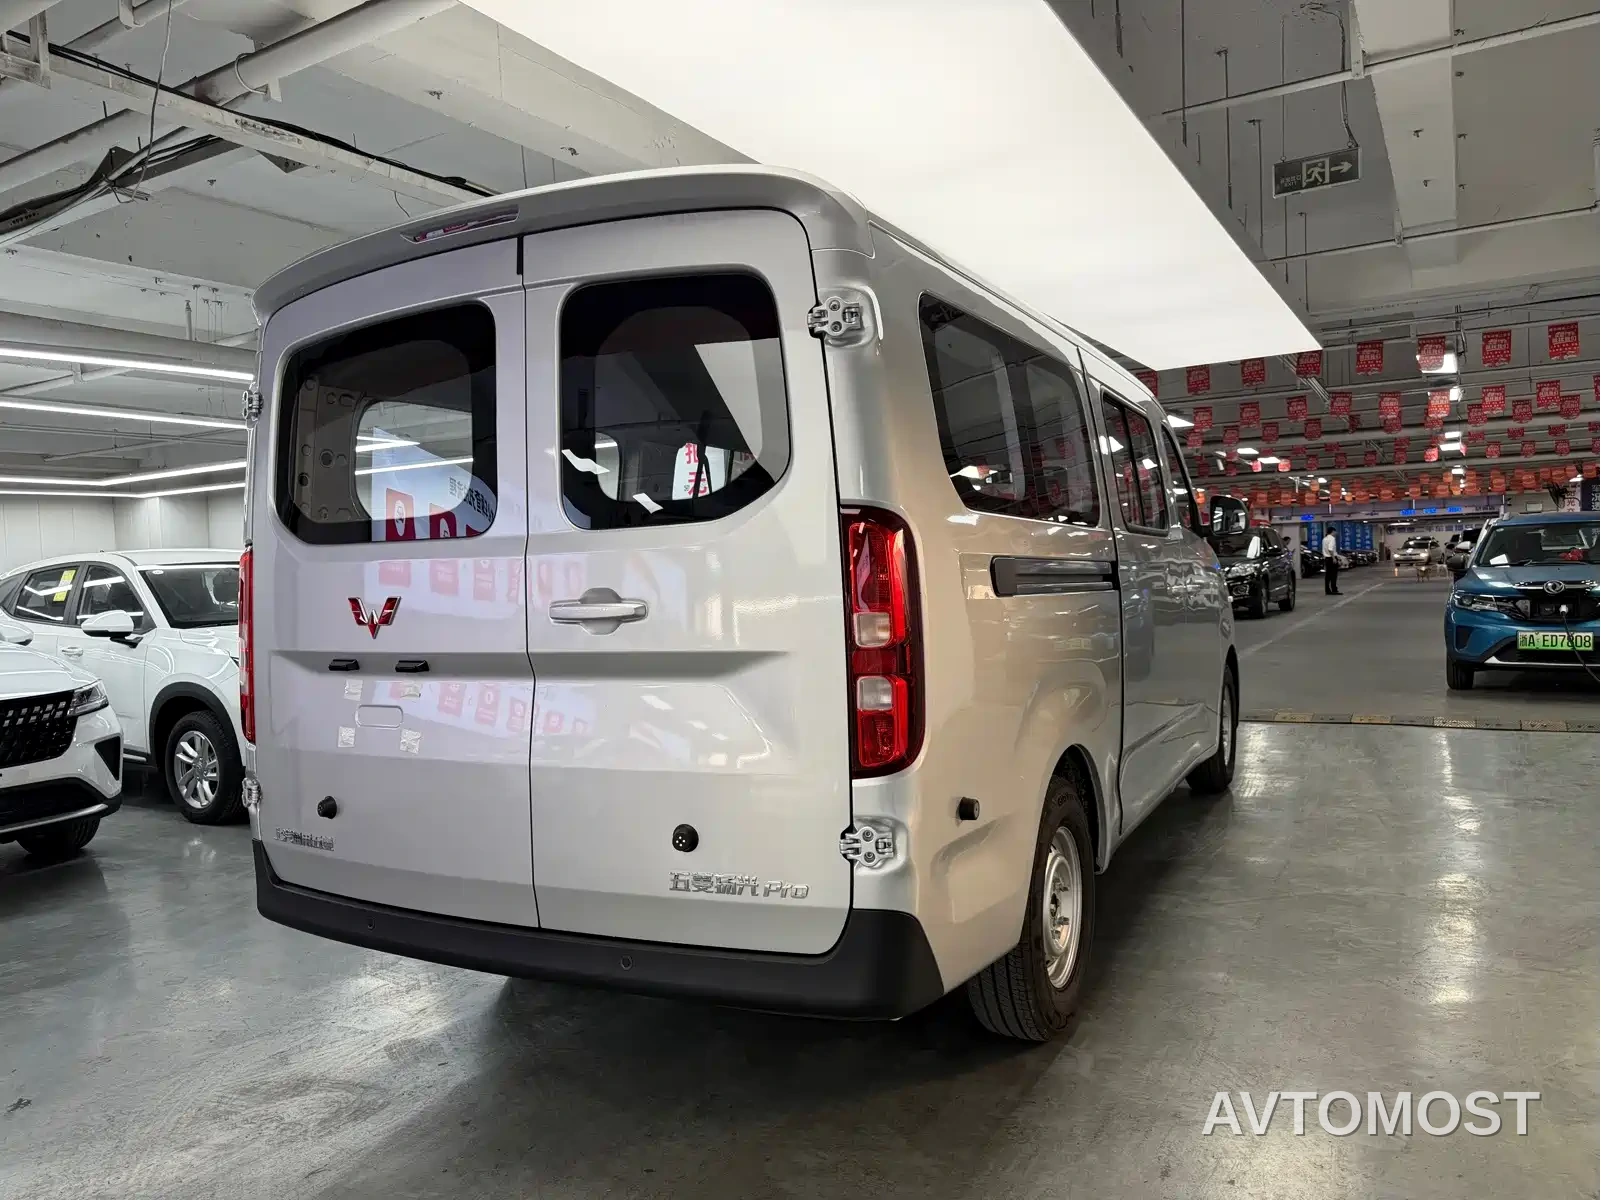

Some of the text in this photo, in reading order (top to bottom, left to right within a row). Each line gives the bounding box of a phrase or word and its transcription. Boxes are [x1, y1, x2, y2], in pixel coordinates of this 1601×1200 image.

[1542, 634, 1592, 648] ED7808
[669, 871, 814, 901] 五菱扬光 Pro
